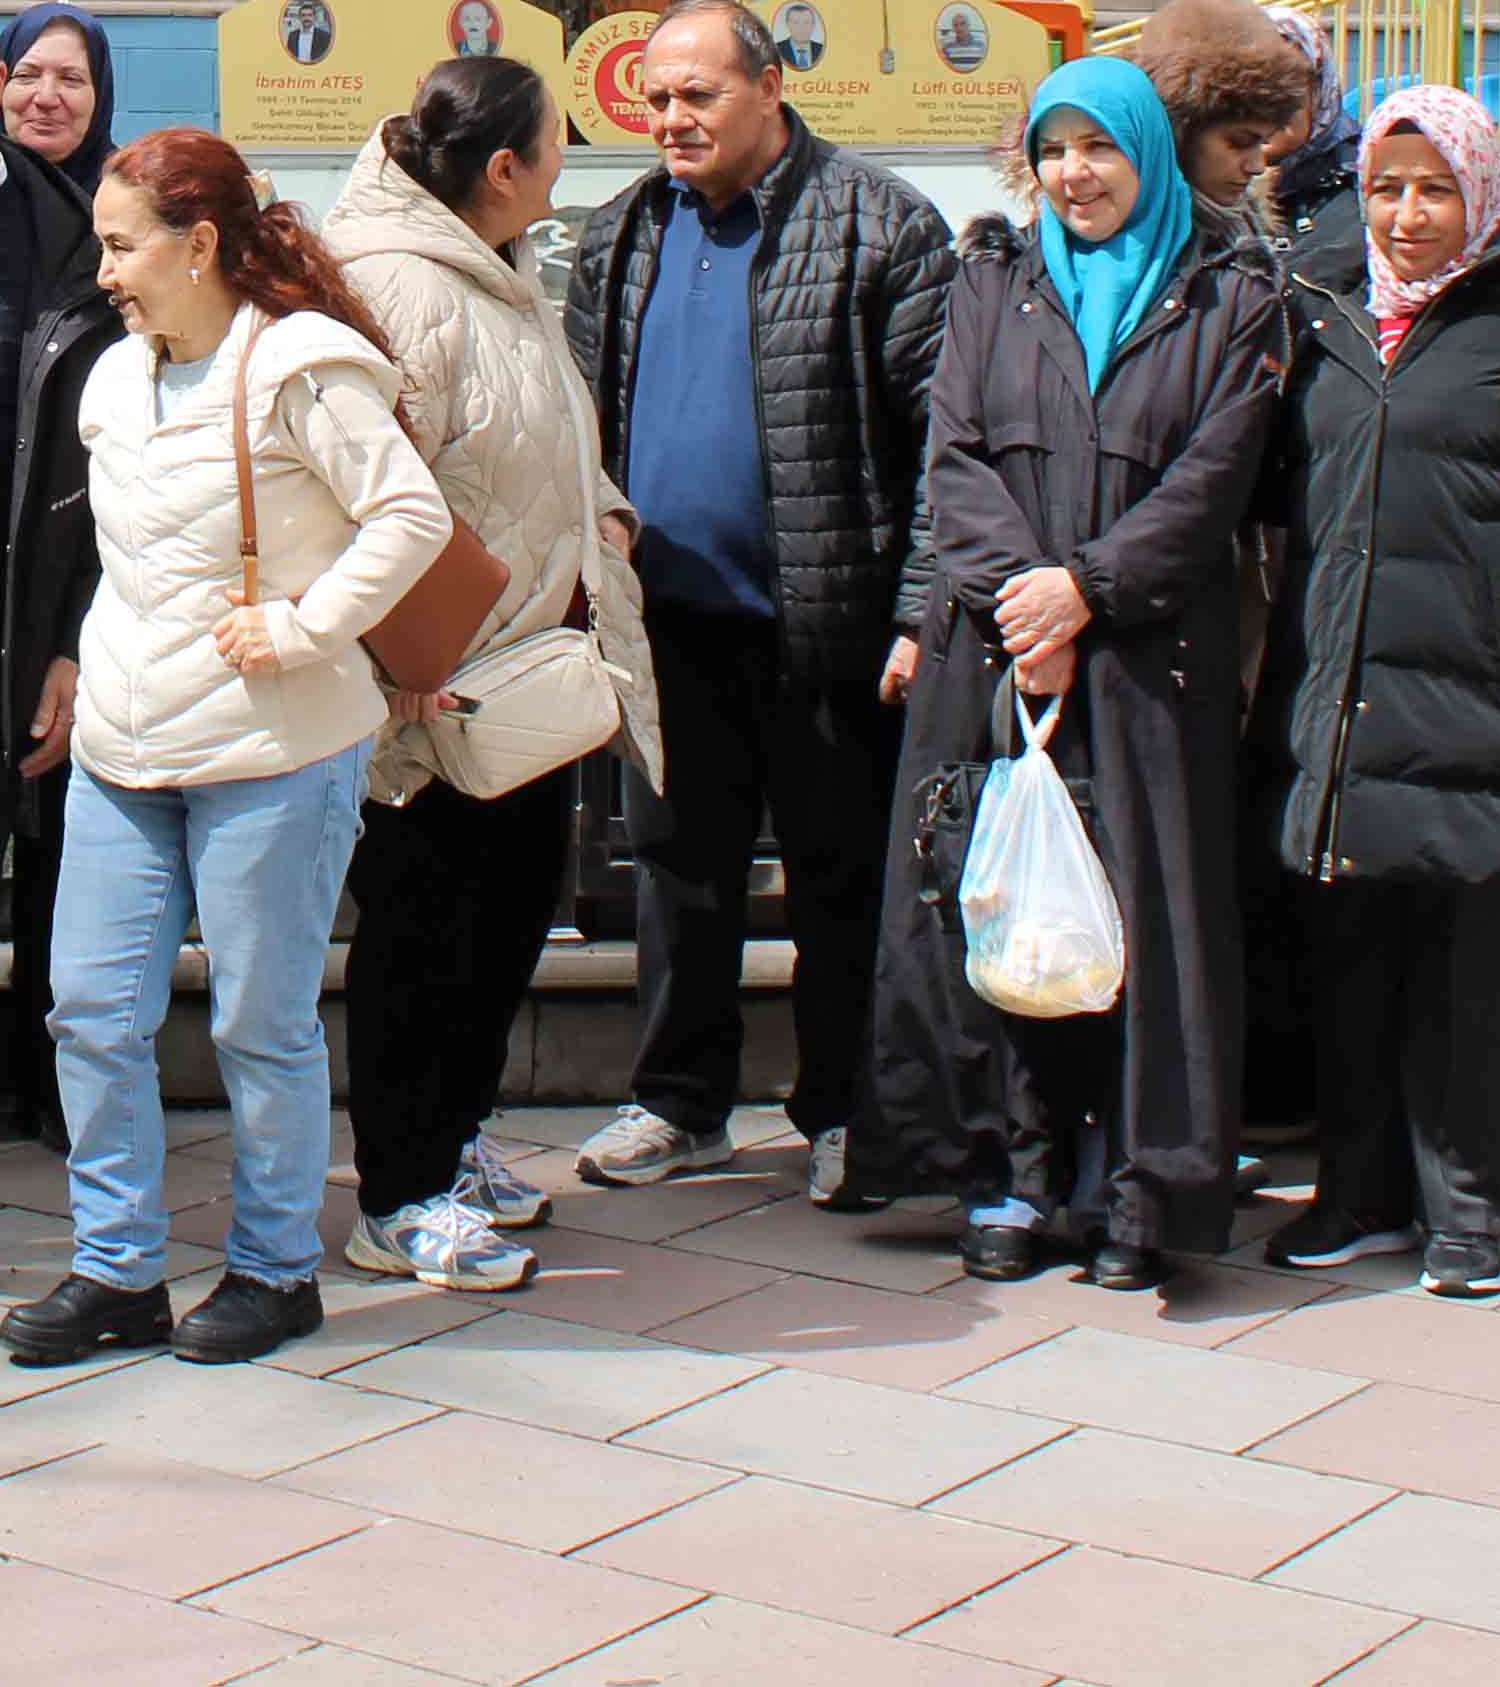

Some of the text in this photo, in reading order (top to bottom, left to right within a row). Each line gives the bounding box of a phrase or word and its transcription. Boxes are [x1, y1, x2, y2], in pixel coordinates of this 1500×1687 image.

[573, 23, 623, 102] TEMMUZ
[255, 71, 364, 91] İbrahim ATEŞ
[801, 78, 871, 96] GÜLŞEN
[912, 79, 1020, 97] Lütfi GÜLŞEN
